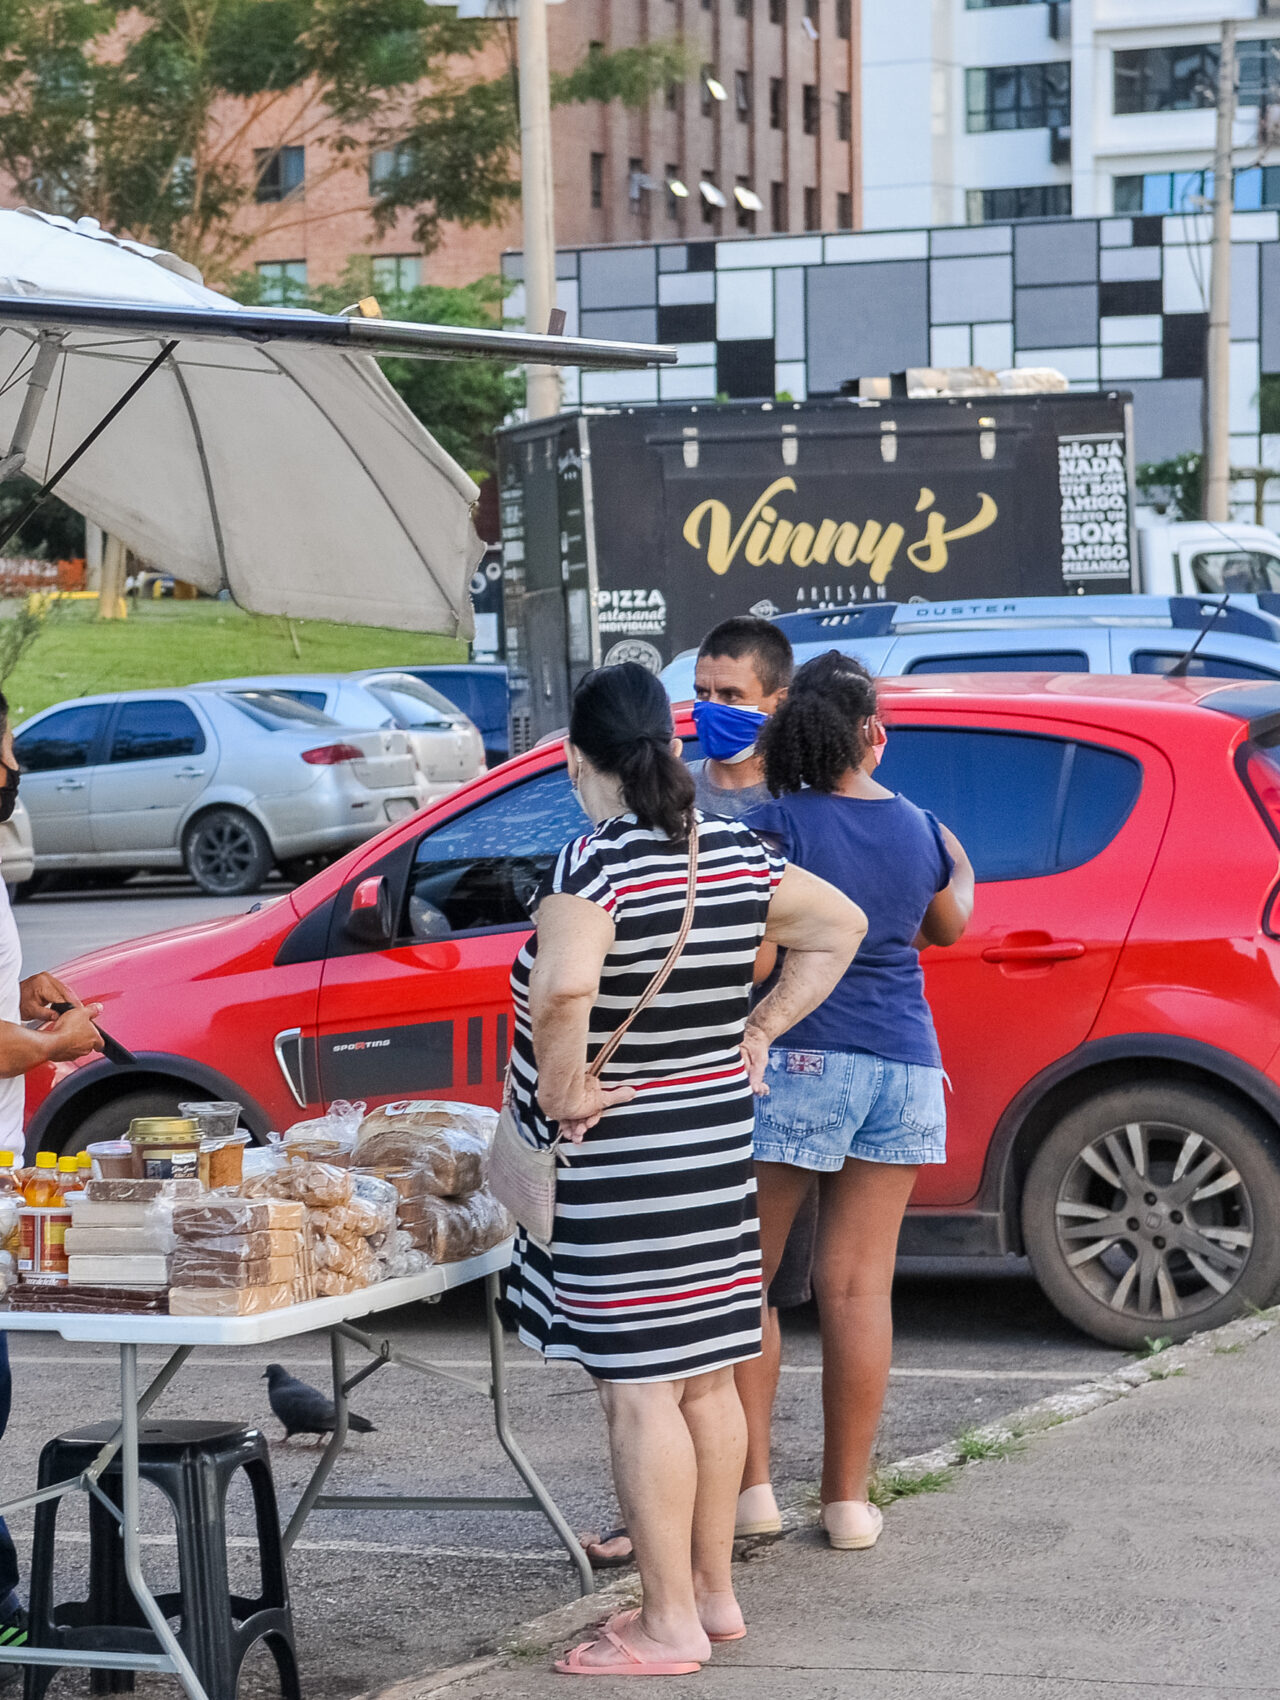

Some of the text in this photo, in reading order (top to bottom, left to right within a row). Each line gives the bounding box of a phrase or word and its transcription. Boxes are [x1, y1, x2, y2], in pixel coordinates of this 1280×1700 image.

[1058, 439, 1124, 459] NÃO HÁ
[1059, 457, 1124, 475] NADA
[1060, 481, 1127, 497] UM BOM
[682, 476, 998, 584] Vinny's
[1061, 521, 1128, 546] BOM
[1062, 543, 1128, 560] AMIGO
[1062, 560, 1130, 573] PIZZAIOLO
[598, 589, 666, 609] PIZZA
[916, 604, 1016, 617] DUSTER
